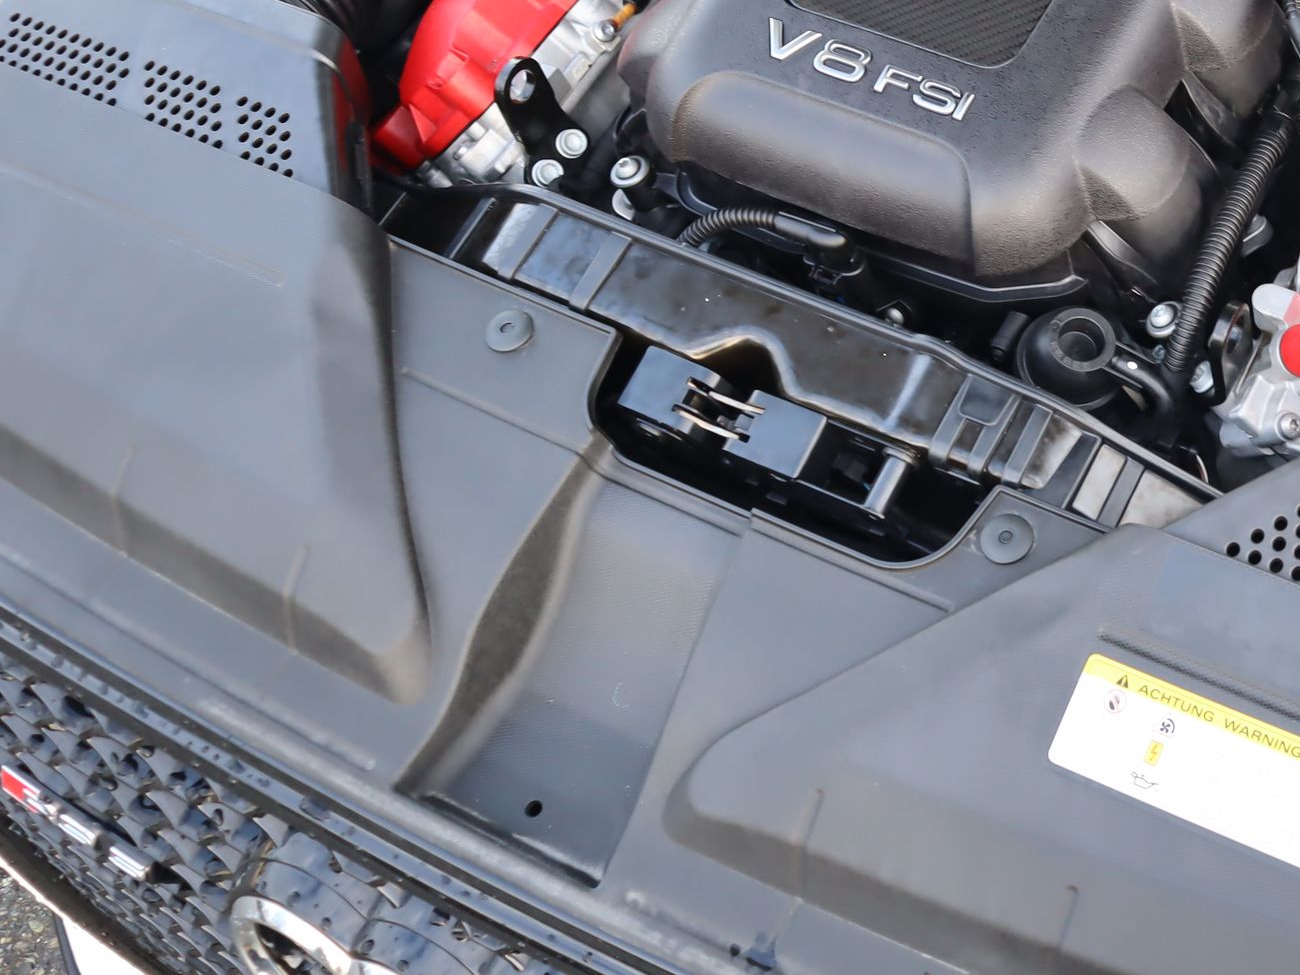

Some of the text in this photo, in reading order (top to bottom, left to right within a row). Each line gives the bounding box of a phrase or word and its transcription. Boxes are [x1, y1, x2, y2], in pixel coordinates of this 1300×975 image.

[769, 17, 976, 121] V8 FSI
[1137, 682, 1216, 723] ACHTUNG
